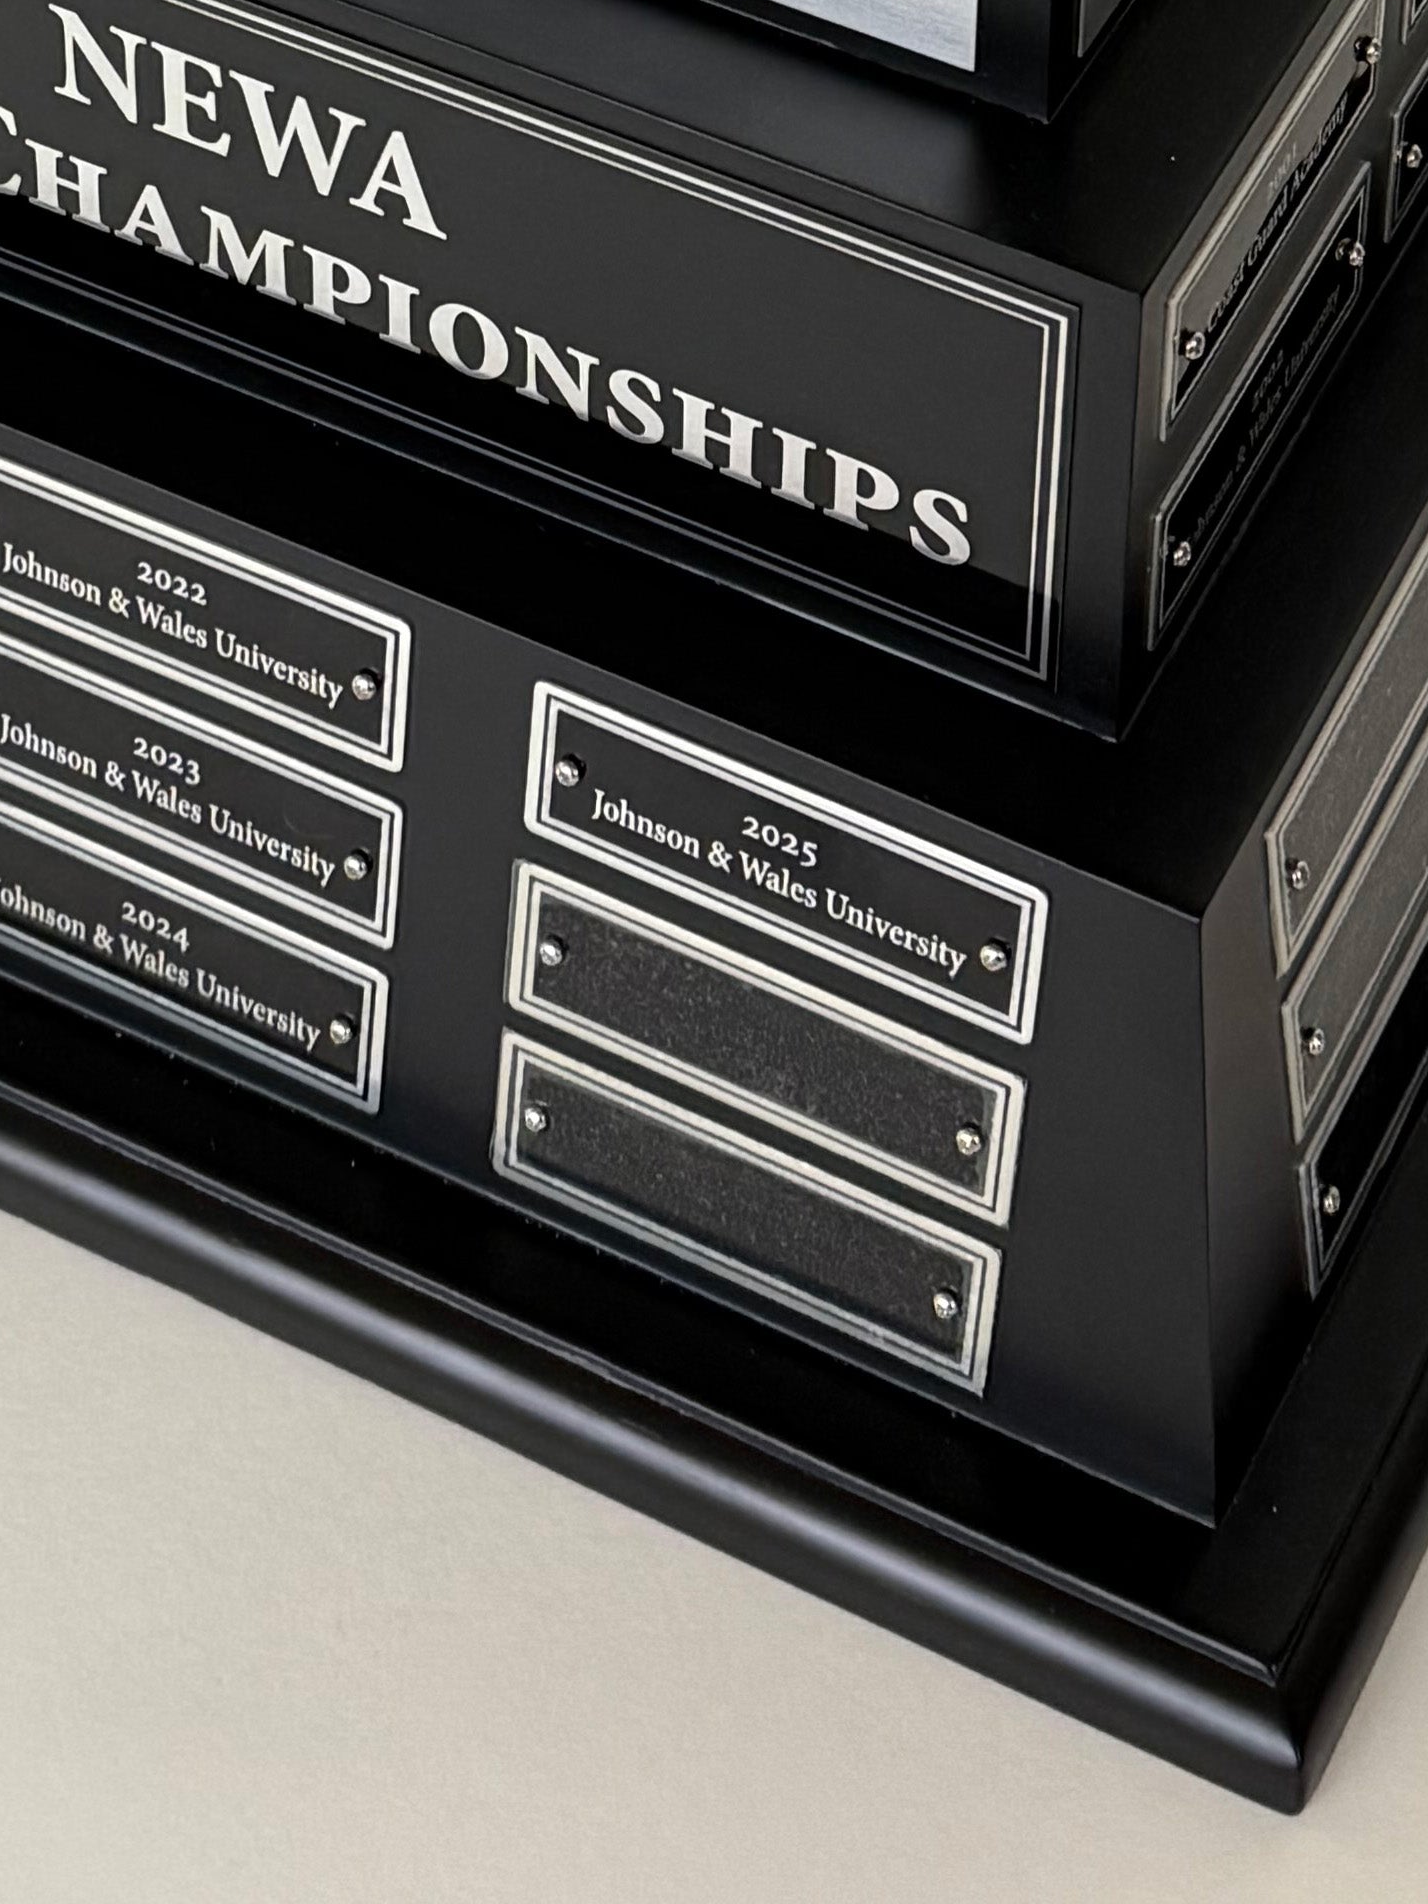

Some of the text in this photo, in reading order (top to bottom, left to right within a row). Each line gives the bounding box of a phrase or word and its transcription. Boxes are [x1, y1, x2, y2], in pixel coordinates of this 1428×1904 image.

[47, 2, 447, 241] NEWA
[1, 540, 344, 710] Johnson & Wales University
[135, 560, 208, 606] 2022
[103, 759, 127, 792] &
[130, 768, 202, 824] Wales
[207, 802, 336, 887] University
[132, 735, 201, 785] 2023
[590, 787, 967, 977] Johnson & Wales University
[740, 814, 818, 867] 2025
[91, 922, 115, 955] &
[118, 932, 190, 988] Wales
[195, 966, 321, 1052] University
[120, 900, 190, 953] 2024
